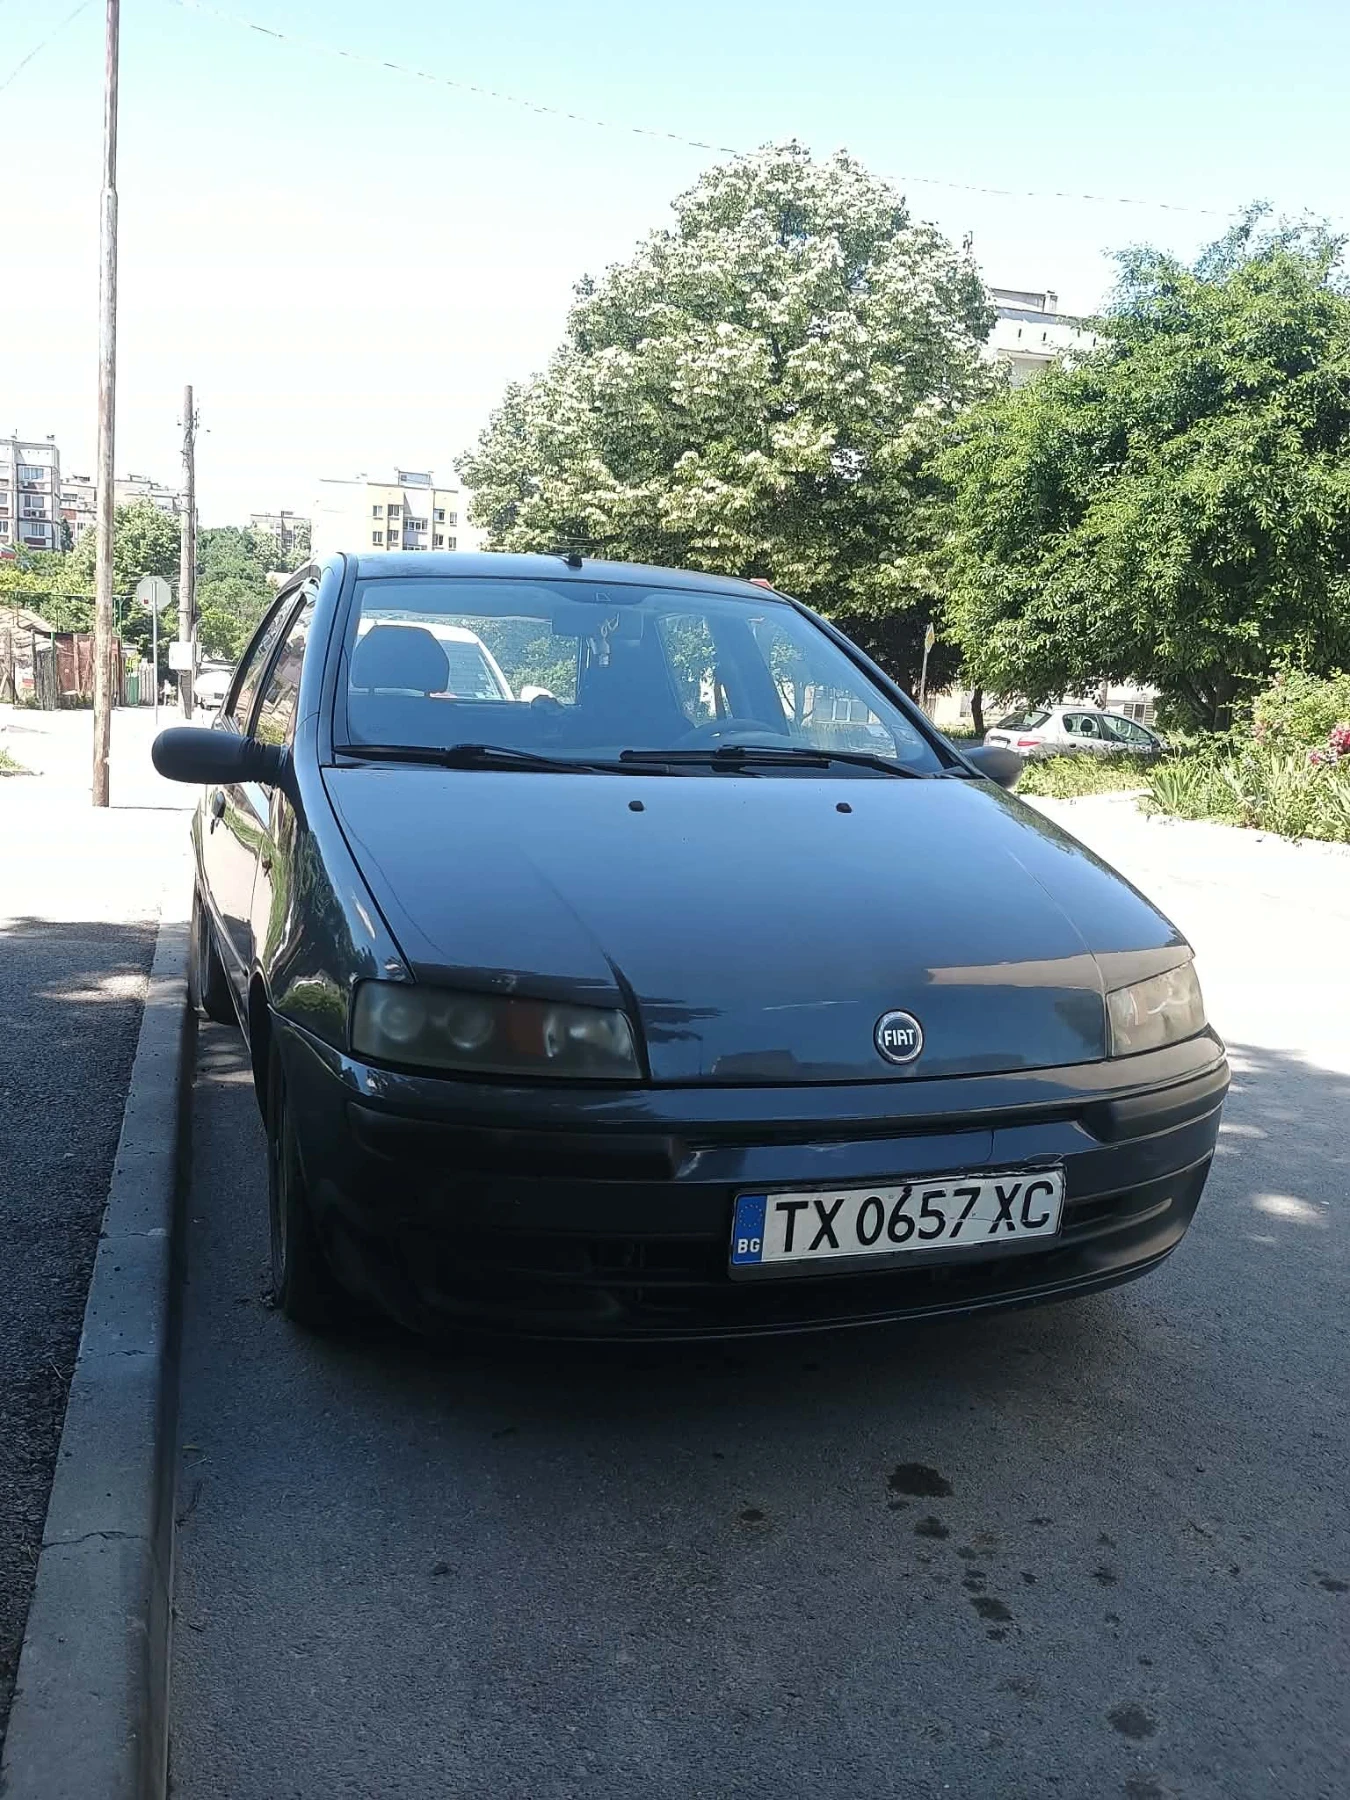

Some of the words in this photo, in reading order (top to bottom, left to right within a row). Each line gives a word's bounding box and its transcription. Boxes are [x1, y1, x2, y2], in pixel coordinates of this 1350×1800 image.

[884, 1029, 915, 1046] FIAT
[775, 1198, 845, 1253] TX
[856, 1186, 981, 1246] 0657
[988, 1180, 1054, 1234] XC
[737, 1238, 760, 1254] BG
